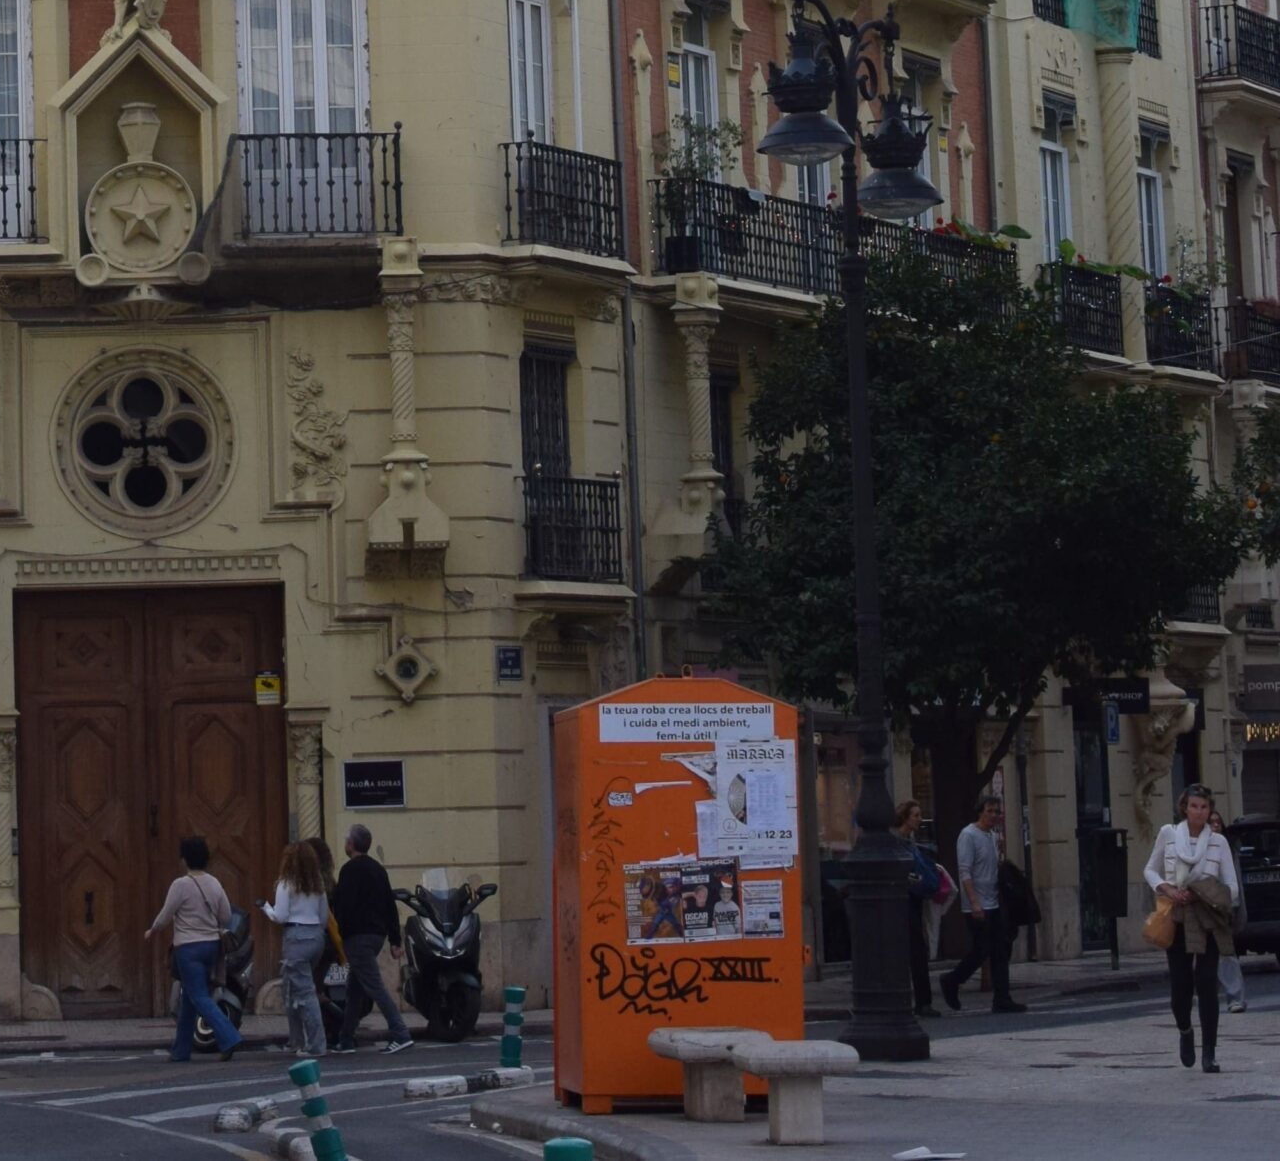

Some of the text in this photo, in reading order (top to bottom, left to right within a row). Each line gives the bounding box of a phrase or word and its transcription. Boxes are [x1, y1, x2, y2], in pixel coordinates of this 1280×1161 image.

[602, 704, 771, 715] la teua roba crea llocs de treball
[629, 718, 658, 728] cuida
[660, 718, 671, 728] el
[673, 717, 700, 728] medi
[702, 718, 751, 729] ambient,
[656, 731, 691, 741] fem-la
[693, 730, 711, 741] útil
[779, 830, 793, 839] 23
